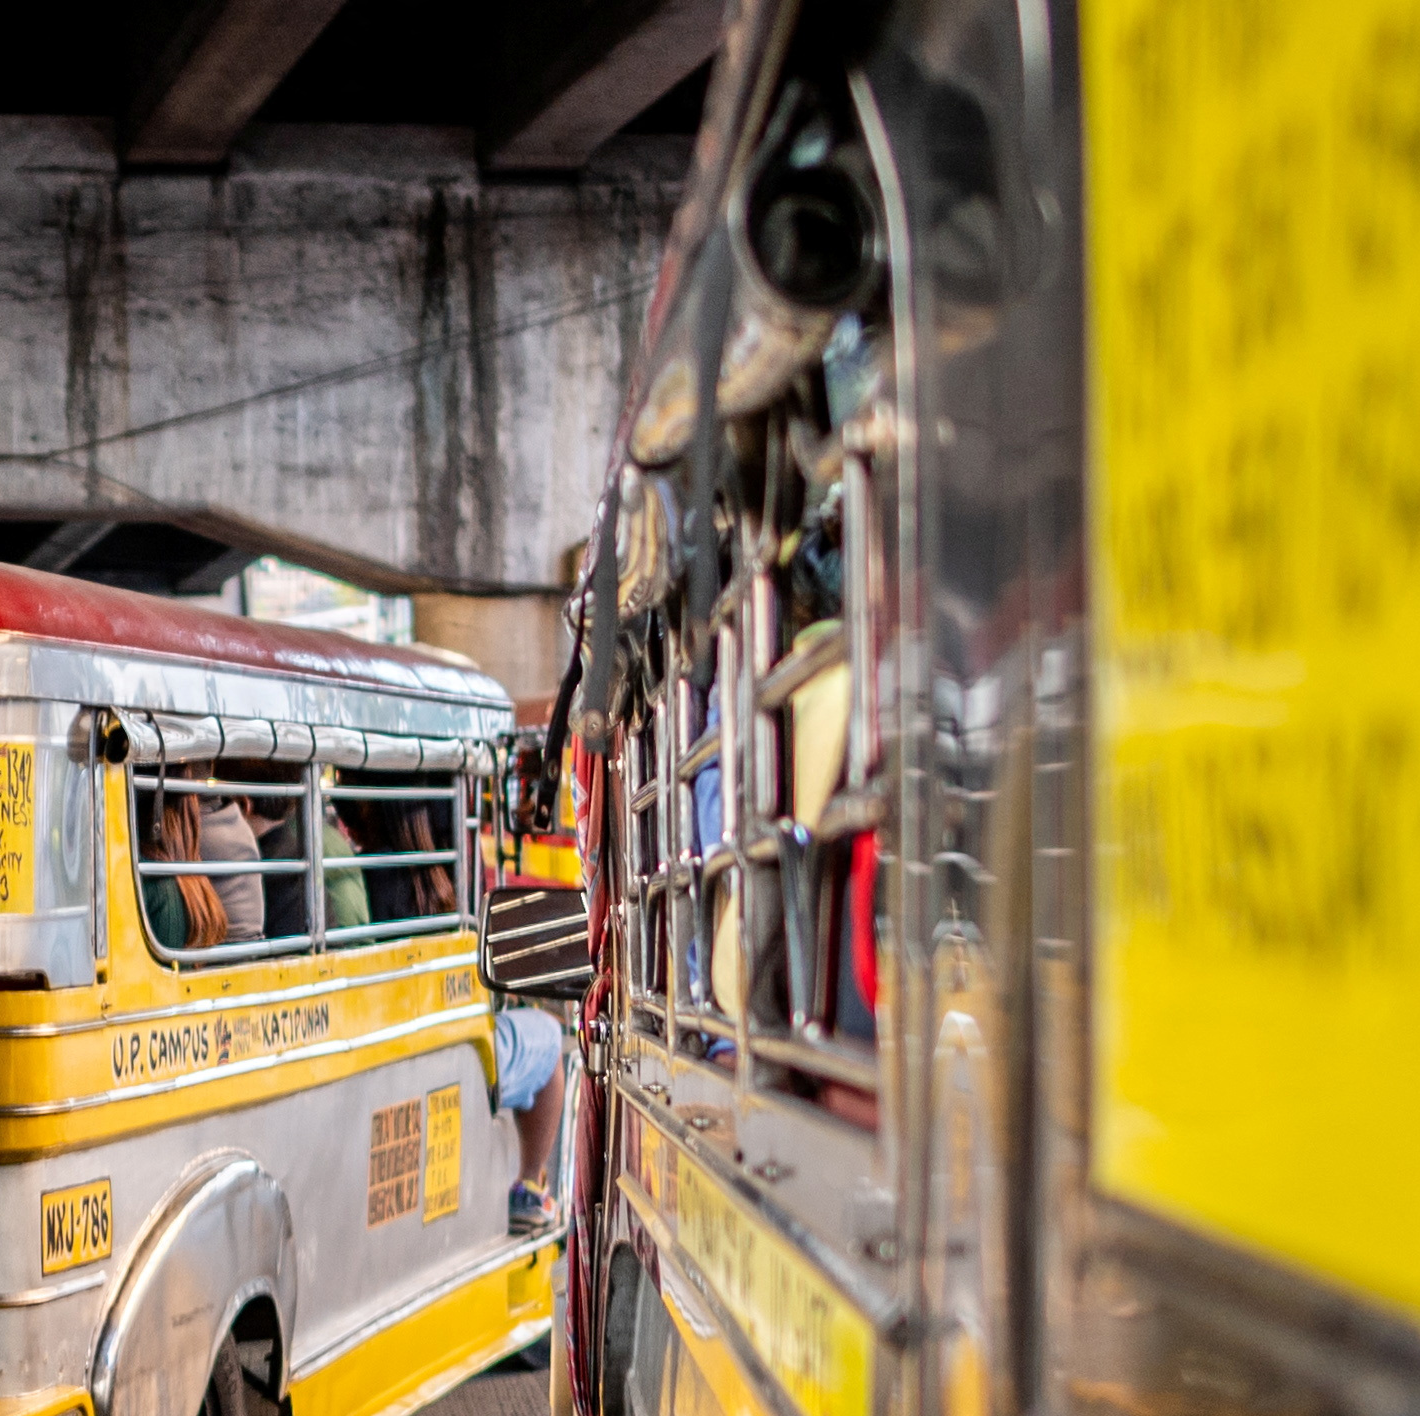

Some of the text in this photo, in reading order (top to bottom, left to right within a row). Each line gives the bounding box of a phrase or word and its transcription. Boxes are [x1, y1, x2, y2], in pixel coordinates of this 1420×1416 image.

[7, 749, 32, 803] 1342
[112, 1032, 144, 1078] U.P.
[149, 1022, 209, 1071] CAMPUS
[261, 1002, 329, 1048] KATIPUNAN
[46, 1193, 110, 1261] NXJ-786
